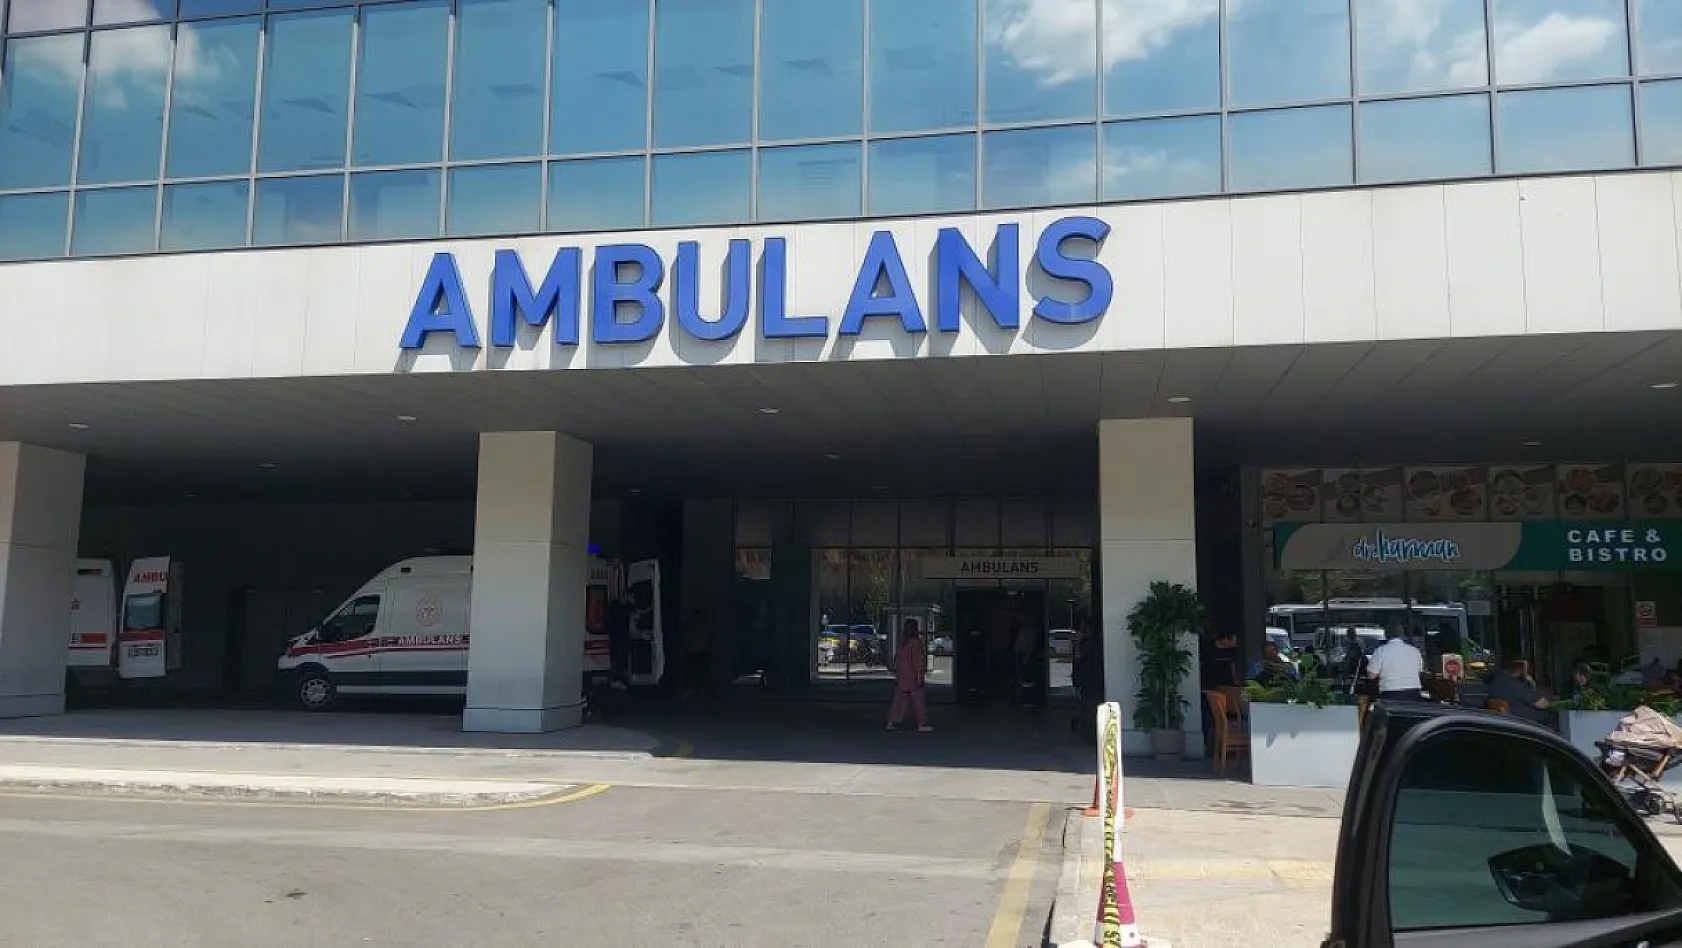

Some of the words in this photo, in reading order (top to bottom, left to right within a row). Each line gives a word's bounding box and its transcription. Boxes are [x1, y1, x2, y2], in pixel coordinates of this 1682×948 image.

[400, 216, 1114, 348] AMBULANS
[1566, 529, 1635, 543] CAFE
[1645, 529, 1661, 543] &
[1568, 547, 1668, 562] BISTRO
[961, 561, 1039, 573] AMBULANS
[398, 634, 463, 646] AMBULANS
